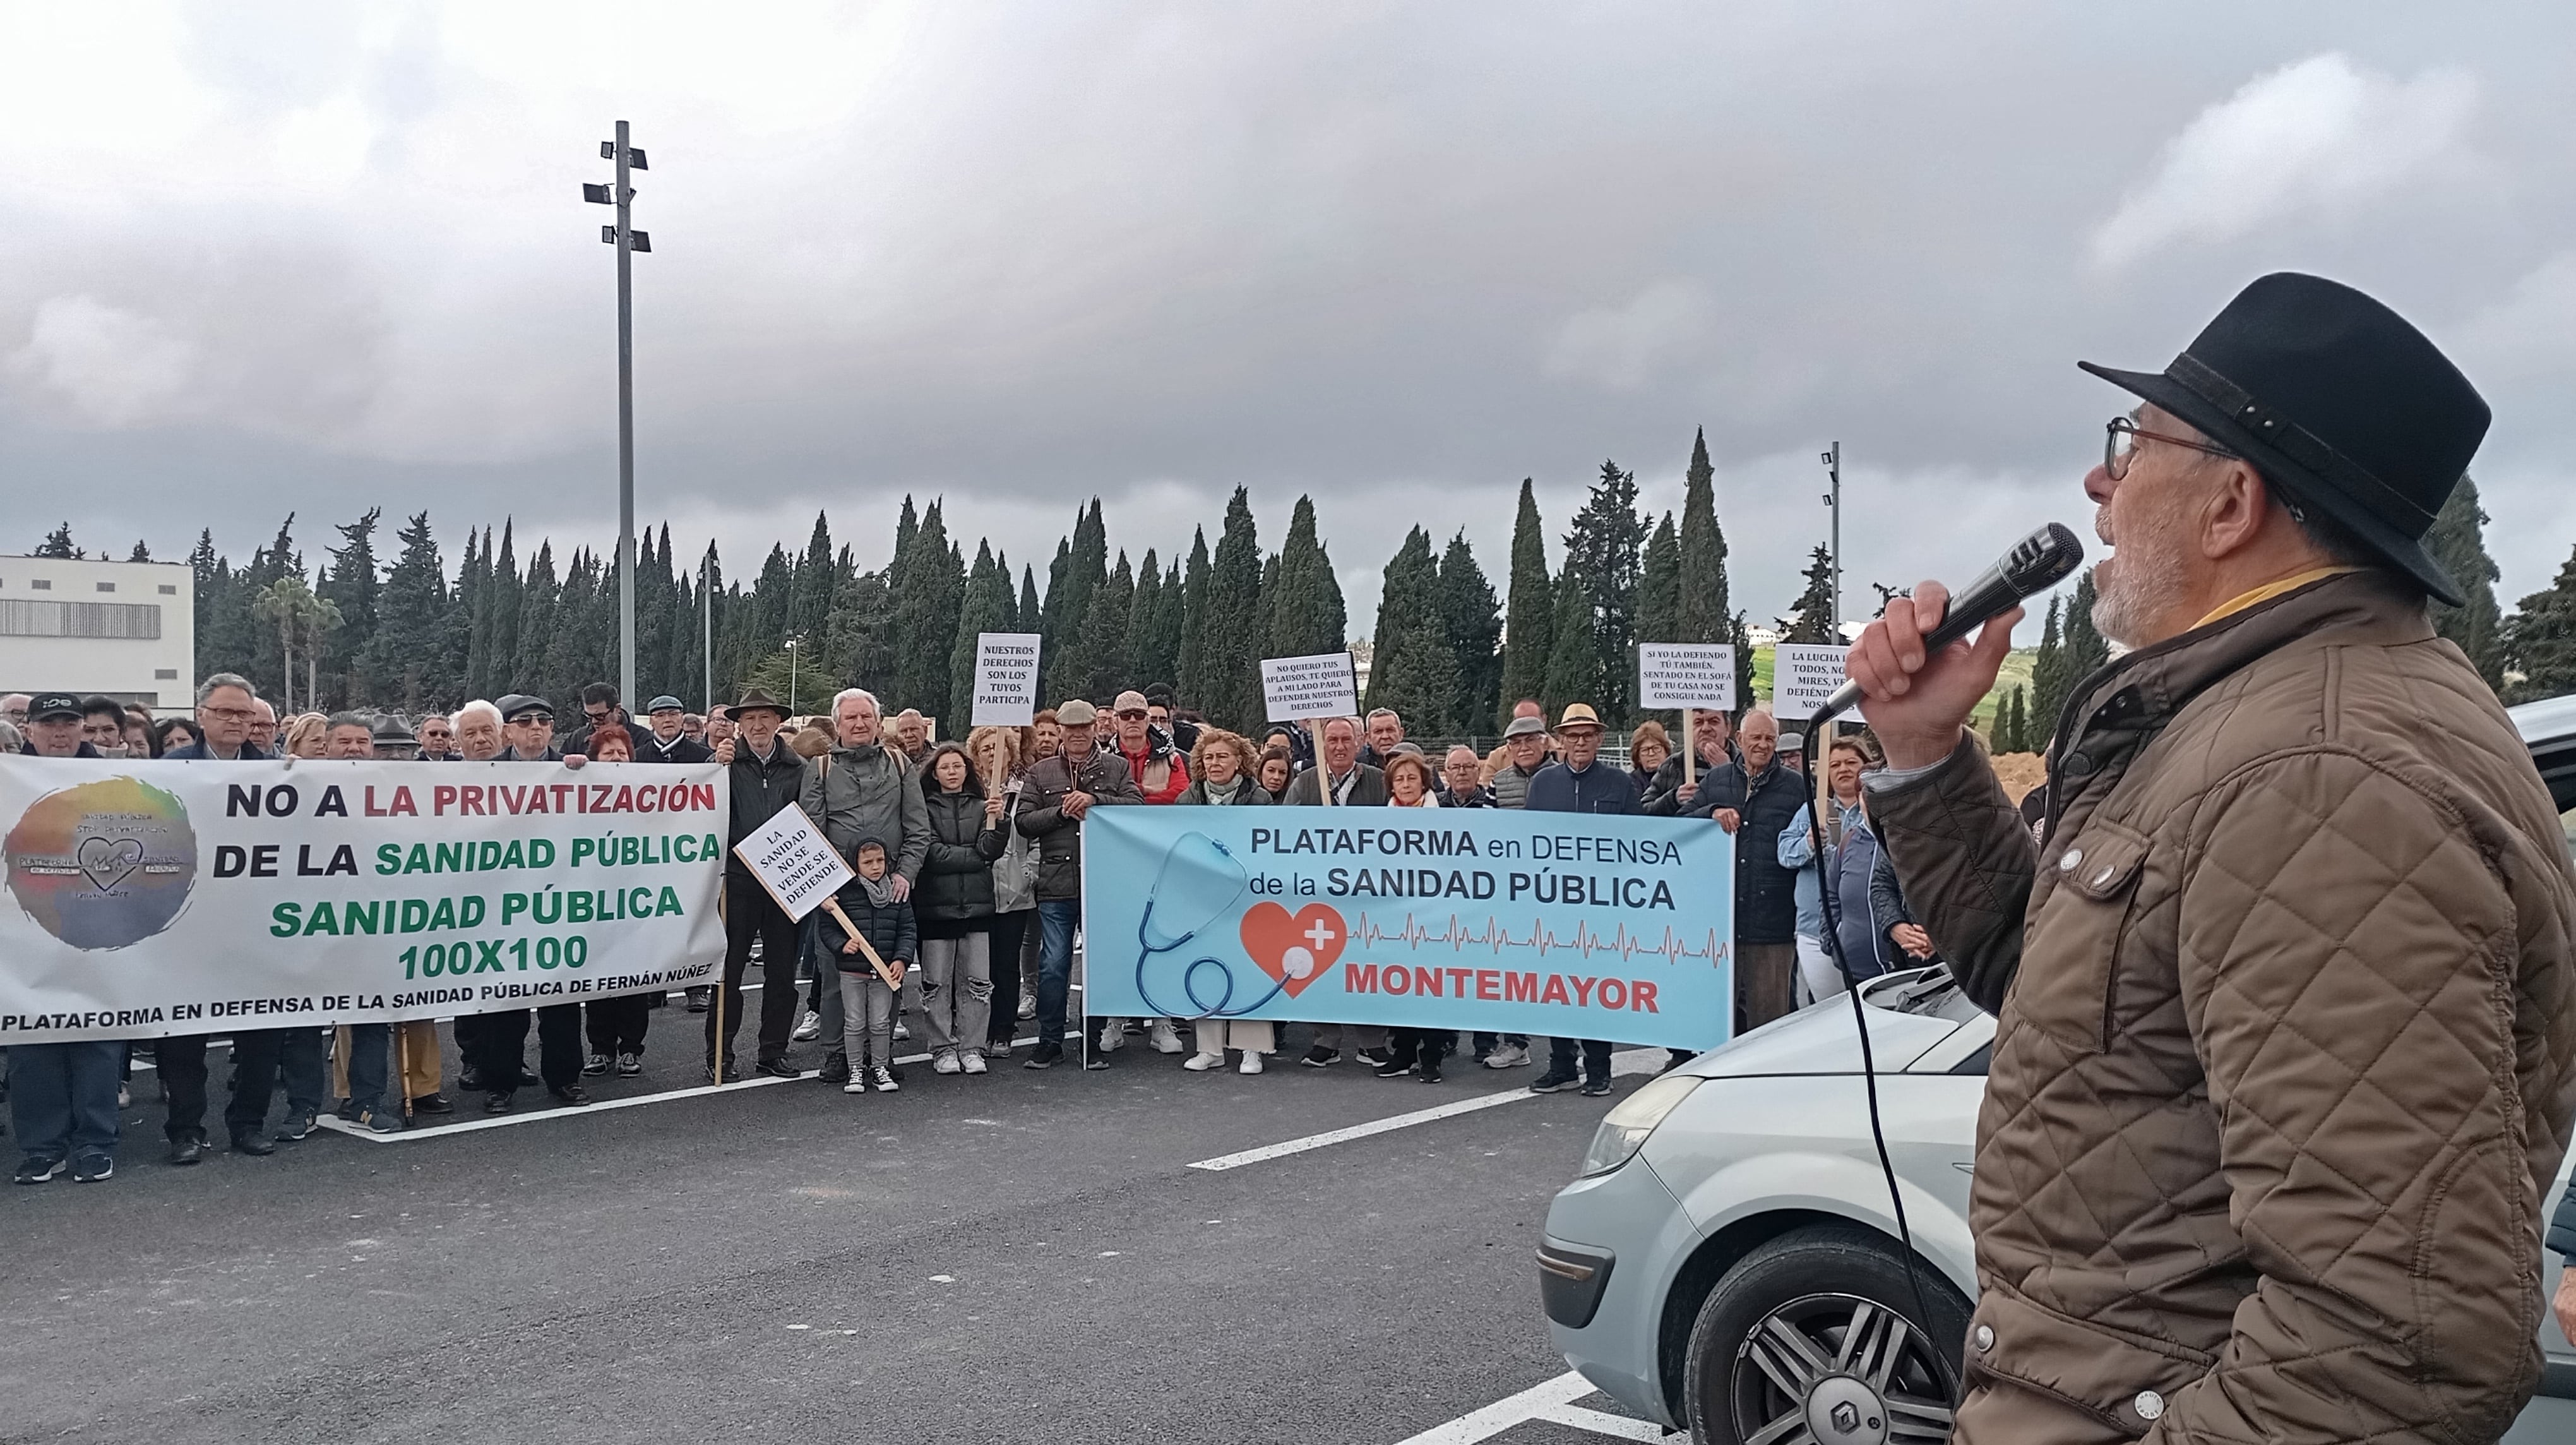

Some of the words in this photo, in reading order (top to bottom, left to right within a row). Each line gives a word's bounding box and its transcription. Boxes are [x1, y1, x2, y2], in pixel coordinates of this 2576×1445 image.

[984, 645, 1034, 655] NUESTROS
[983, 658, 1034, 667] DERECHOS
[1660, 659, 1671, 668] TÚ
[1674, 661, 1715, 669] TAMBIÉN.
[1808, 653, 1840, 662] LUCHA
[1291, 663, 1320, 672] QUIERO
[1792, 664, 1828, 674] TODOS,
[1009, 671, 1027, 680] LOS
[1265, 674, 1308, 683] APLAUSOS,
[1321, 670, 1351, 679] QUIERO
[1798, 677, 1830, 686] MIRES,
[990, 683, 1022, 692] TUYOS
[1297, 683, 1318, 691] LADO
[979, 696, 1030, 704] PARTICIPA
[1268, 693, 1310, 702] DEFENDER
[1312, 689, 1354, 699] NUESTROS
[1291, 701, 1333, 711] DERECHOS
[227, 784, 298, 817] NO
[314, 785, 348, 817] A
[364, 786, 419, 817] LA
[434, 778, 715, 816] PRIVATIZACIÓN
[766, 830, 783, 844] LA
[760, 830, 807, 868] SANIDAD
[1251, 829, 1479, 856] PLATAFORMA
[1488, 839, 1521, 858] en
[1532, 835, 1682, 865] DEFENSA
[213, 844, 280, 878] DE
[297, 844, 359, 876] LA
[375, 838, 556, 875] SANIDAD
[571, 830, 720, 867] PÚBLICA
[777, 858, 795, 873] NO
[794, 846, 809, 861] SE
[777, 861, 814, 891] VENDE
[813, 850, 828, 865] SE
[786, 861, 838, 904] DEFIENDE
[1249, 872, 1283, 895] de
[1294, 872, 1316, 896] la
[1327, 867, 1496, 900] SANIDAD
[1510, 866, 1676, 911] PÚBLICA
[270, 896, 486, 937] SANIDAD
[502, 884, 684, 925] PÚBLICA
[398, 935, 588, 980] 100X100
[1345, 963, 1659, 1014] MONTEMAYOR
[1, 1007, 164, 1031] PLATAFORMA
[172, 1004, 202, 1020] EN
[210, 997, 314, 1017] DEFENSA
[321, 995, 350, 1010] DE
[357, 995, 385, 1009] LA
[391, 987, 474, 1009] SANIDAD
[481, 981, 564, 1000] PÚBLICA
[569, 980, 592, 993] DE
[597, 971, 663, 991] FERNÁN
[665, 963, 713, 982] NÚÑEZ
